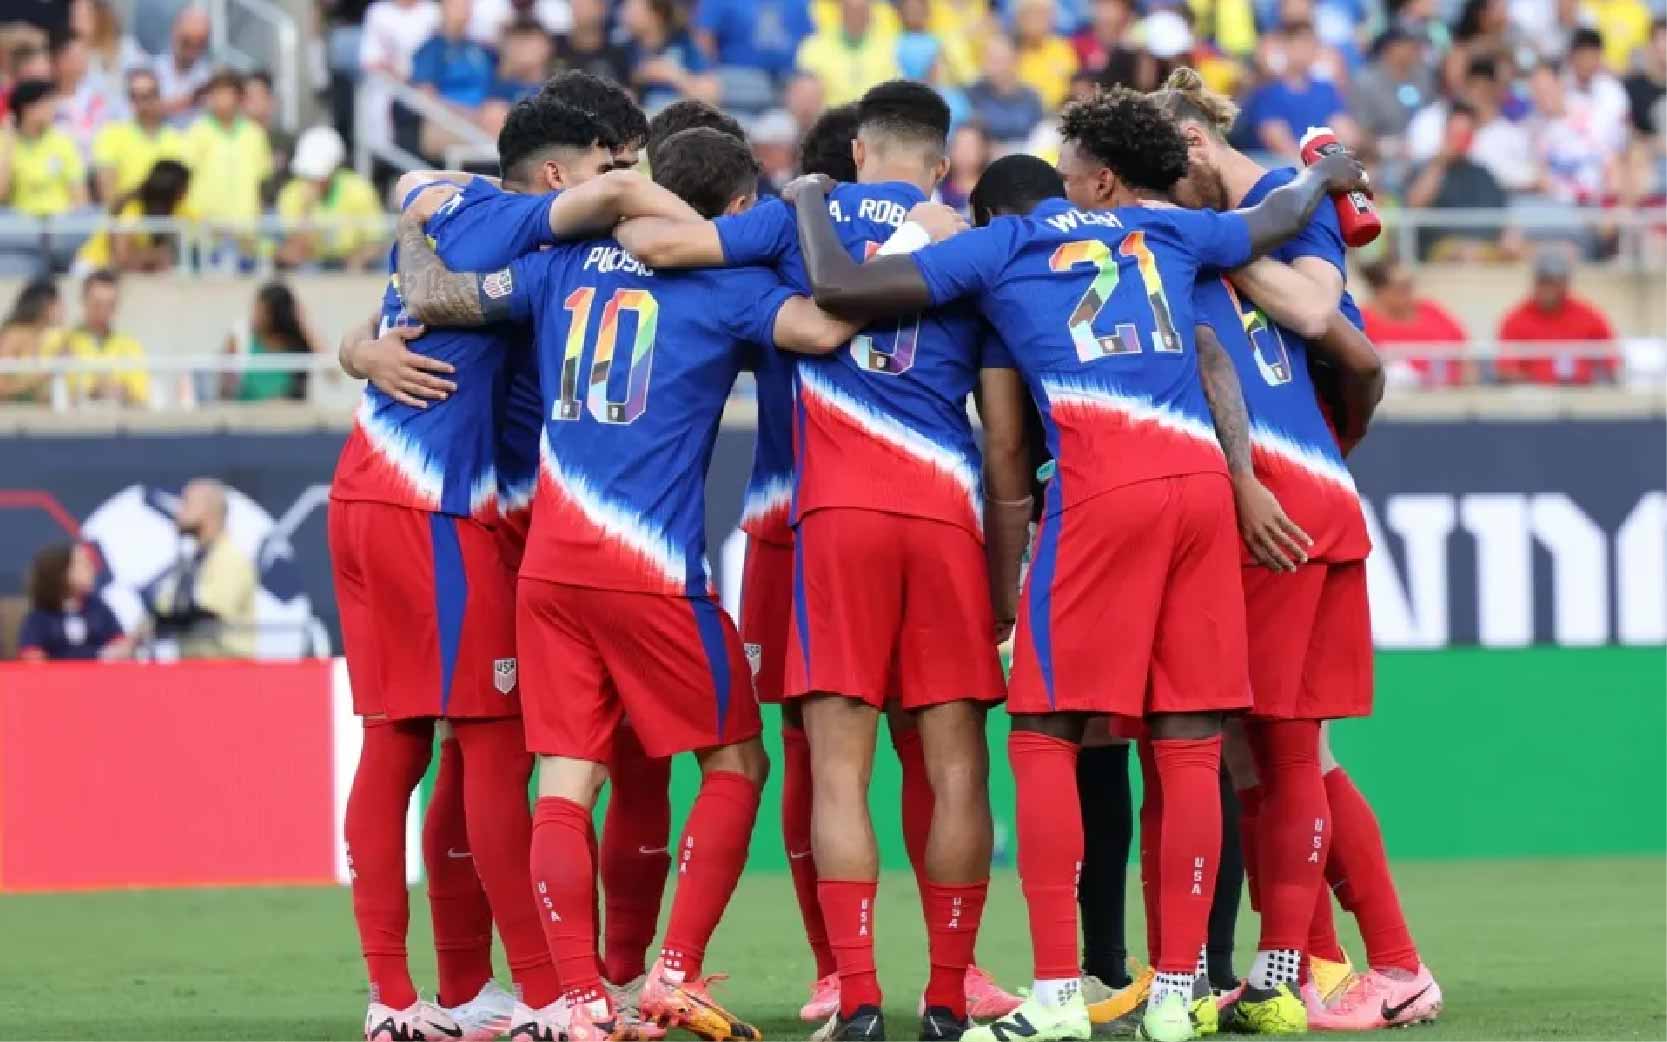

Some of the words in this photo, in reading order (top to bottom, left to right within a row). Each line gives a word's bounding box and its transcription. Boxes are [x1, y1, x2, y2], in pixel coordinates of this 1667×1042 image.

[1048, 230, 1183, 363] 21
[551, 286, 659, 425] 10
[1307, 817, 1323, 863] USA
[1191, 856, 1205, 895] USA
[536, 880, 562, 922] USA
